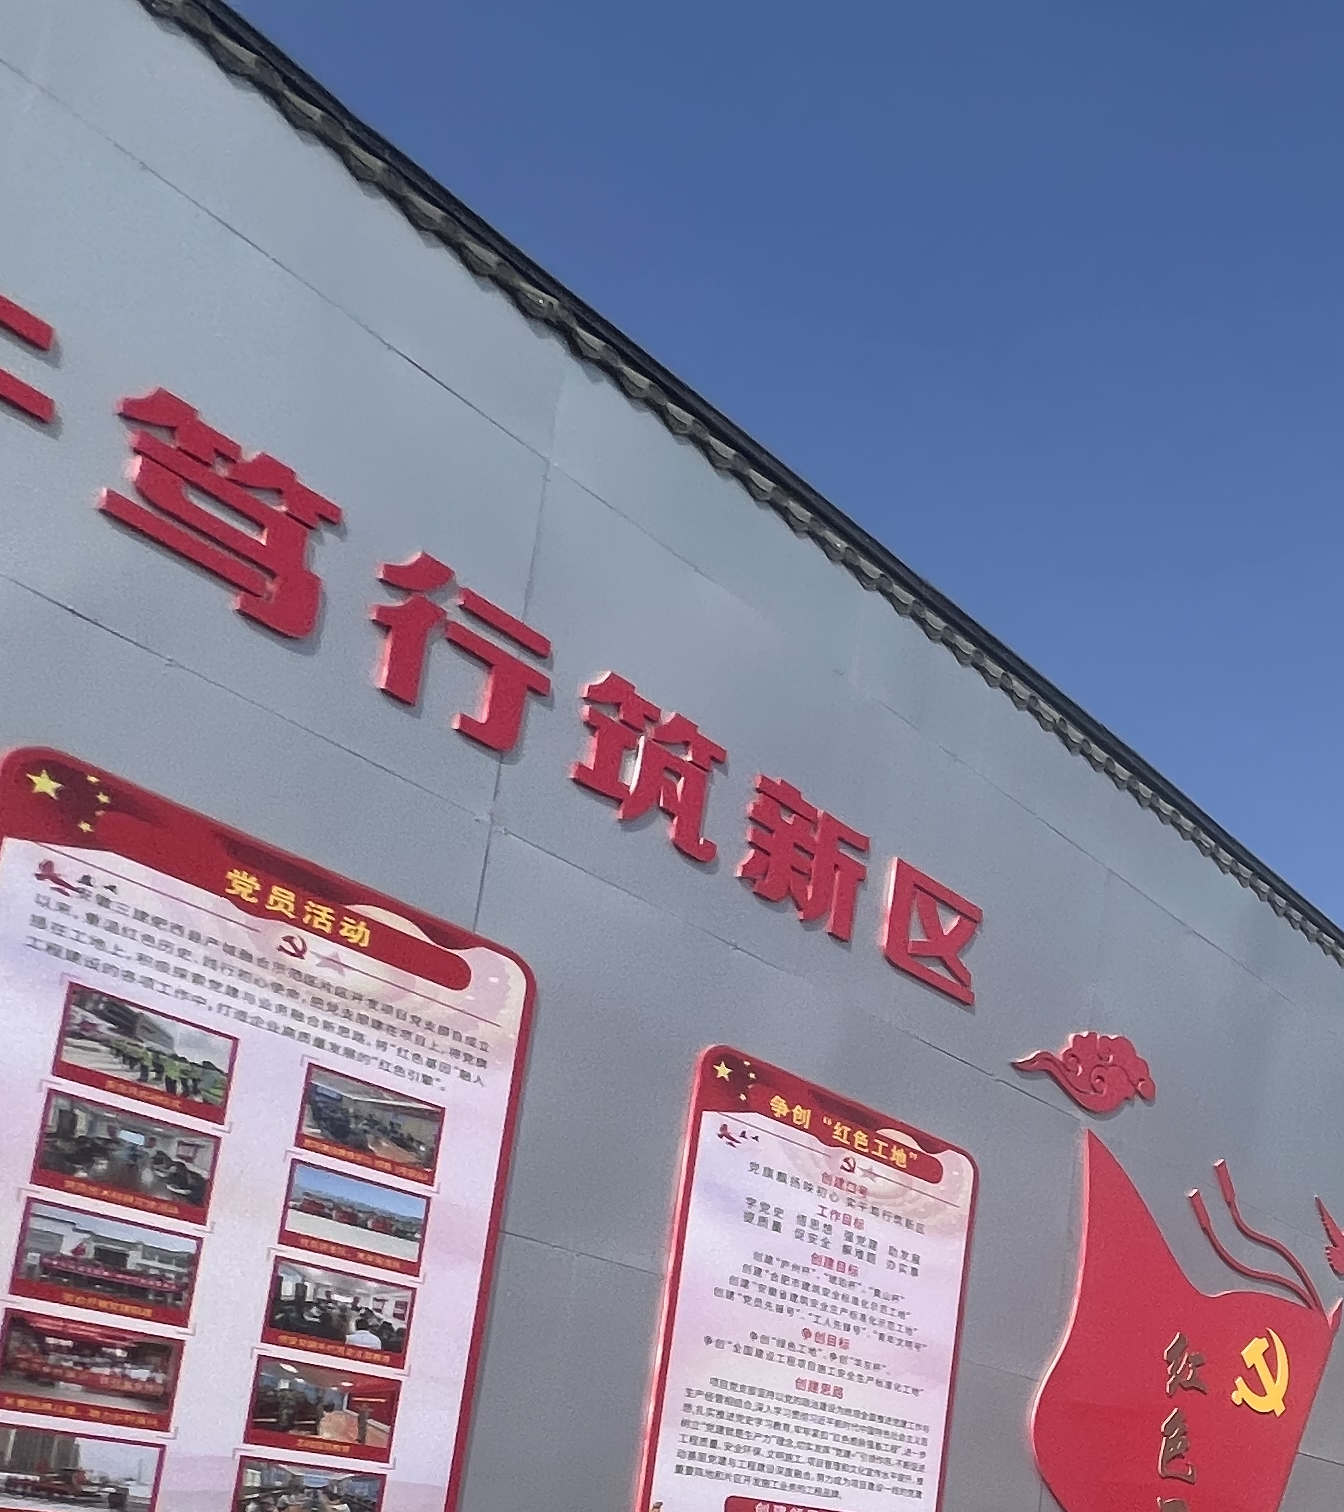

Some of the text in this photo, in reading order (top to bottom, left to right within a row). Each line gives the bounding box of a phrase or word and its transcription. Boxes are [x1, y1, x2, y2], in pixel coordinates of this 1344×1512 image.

[224, 868, 371, 948] 党员活动
[769, 1094, 918, 1169] 争创 “红色工地”
[816, 1204, 866, 1231] 工作目标
[810, 1251, 860, 1278] 创建目标
[801, 1327, 851, 1350] 争创目标
